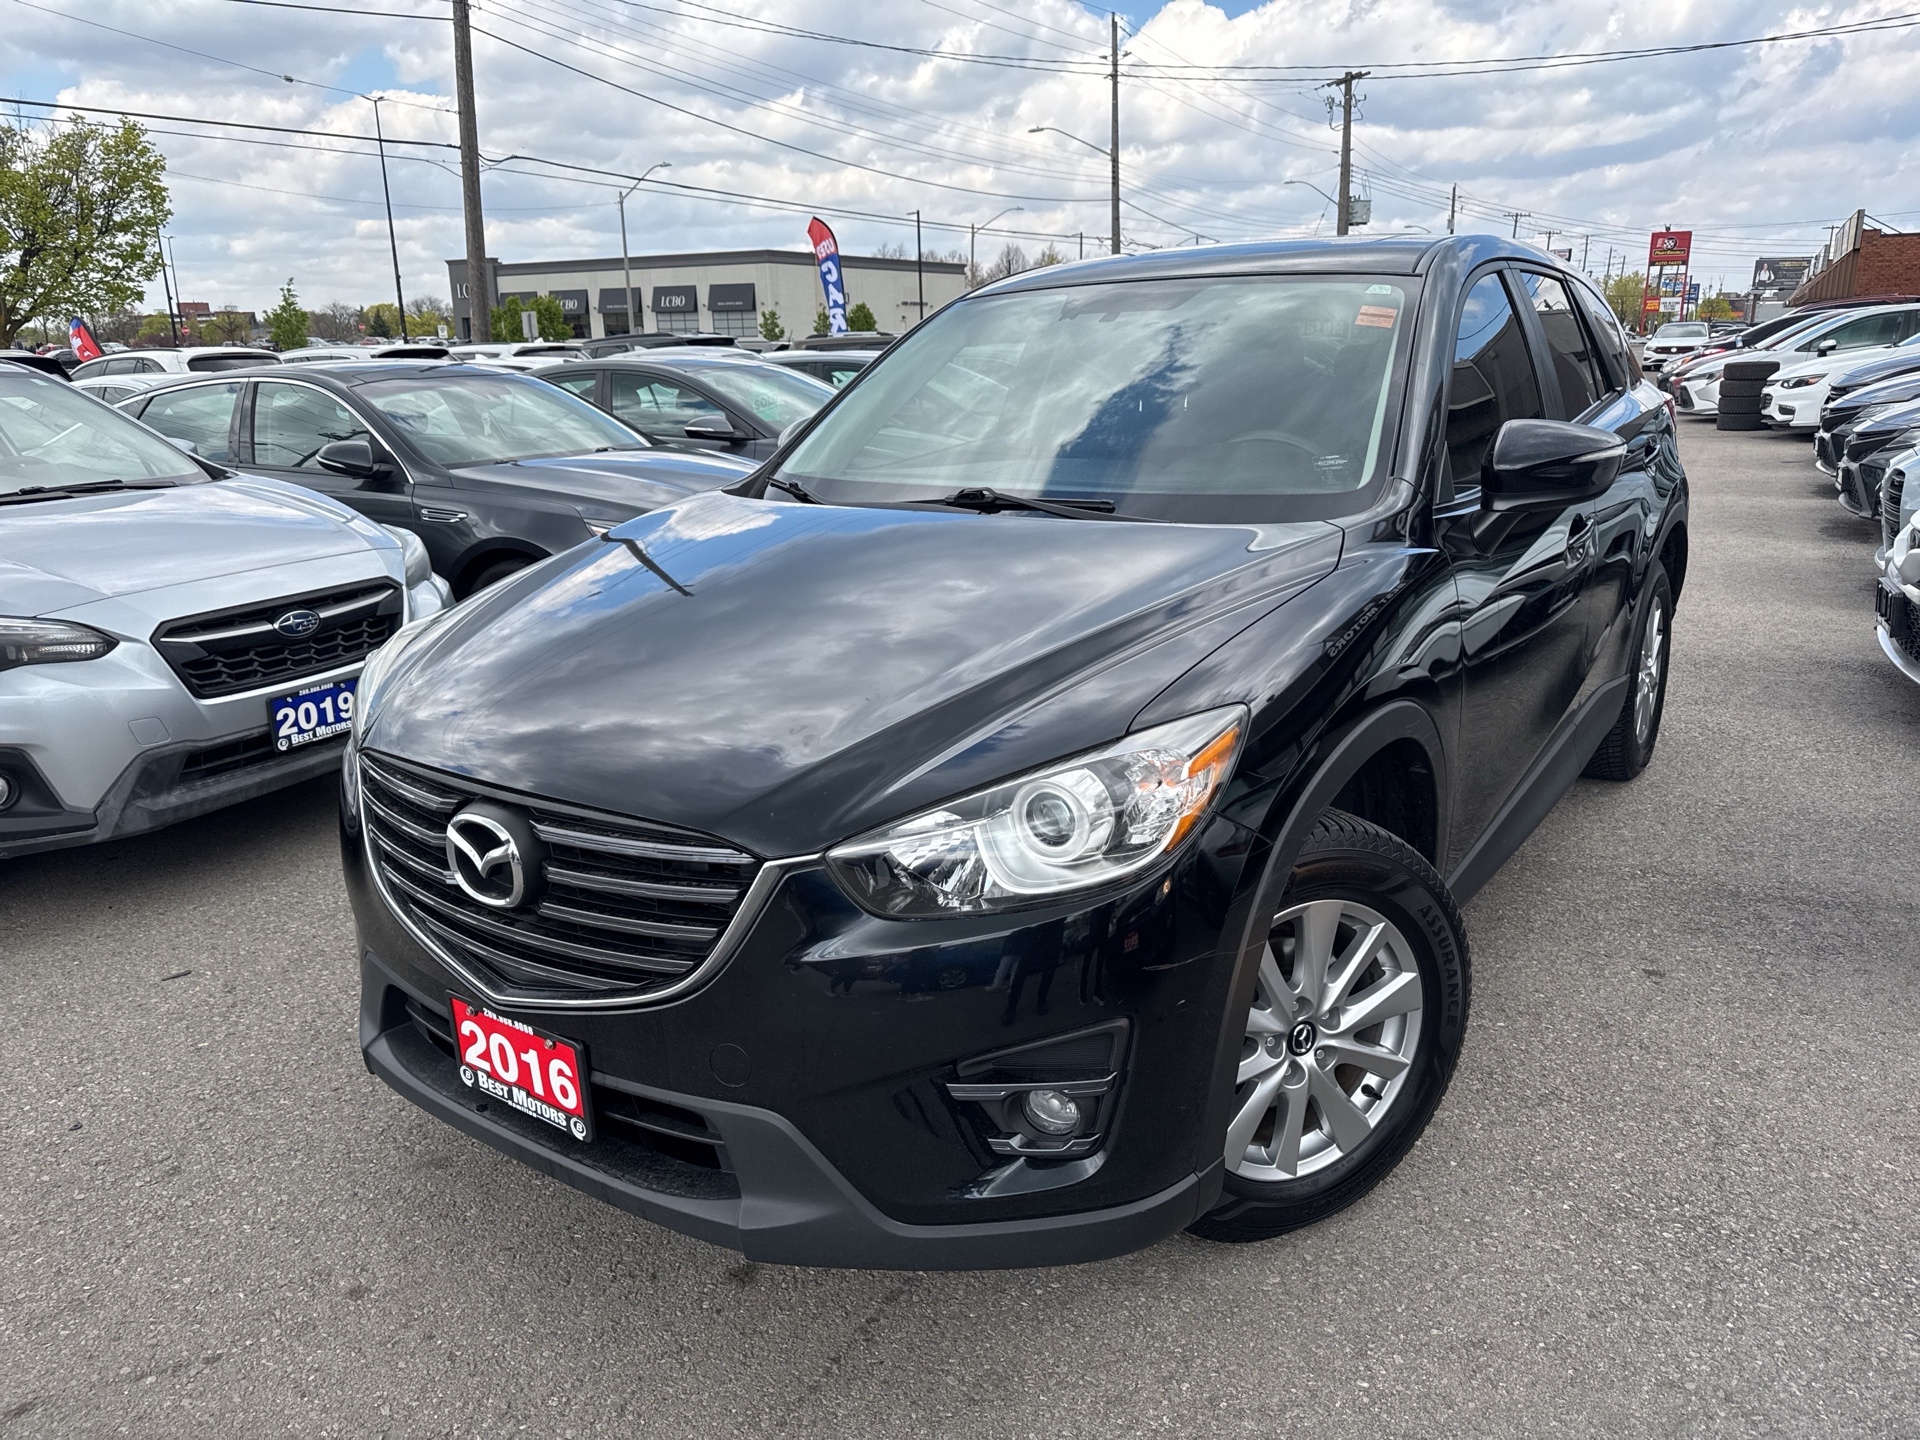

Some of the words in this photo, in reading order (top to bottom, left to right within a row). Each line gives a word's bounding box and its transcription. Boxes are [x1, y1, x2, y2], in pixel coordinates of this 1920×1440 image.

[557, 299, 578, 310] CBO
[660, 295, 686, 308] LCBO
[276, 691, 354, 738] 2019
[291, 731, 313, 745] BEST
[315, 720, 352, 737] MOTORS
[1417, 904, 1460, 1027] ASSURANCE
[461, 1020, 578, 1110] 2016
[477, 1070, 509, 1099] BEST
[511, 1086, 567, 1127] MOTORS
